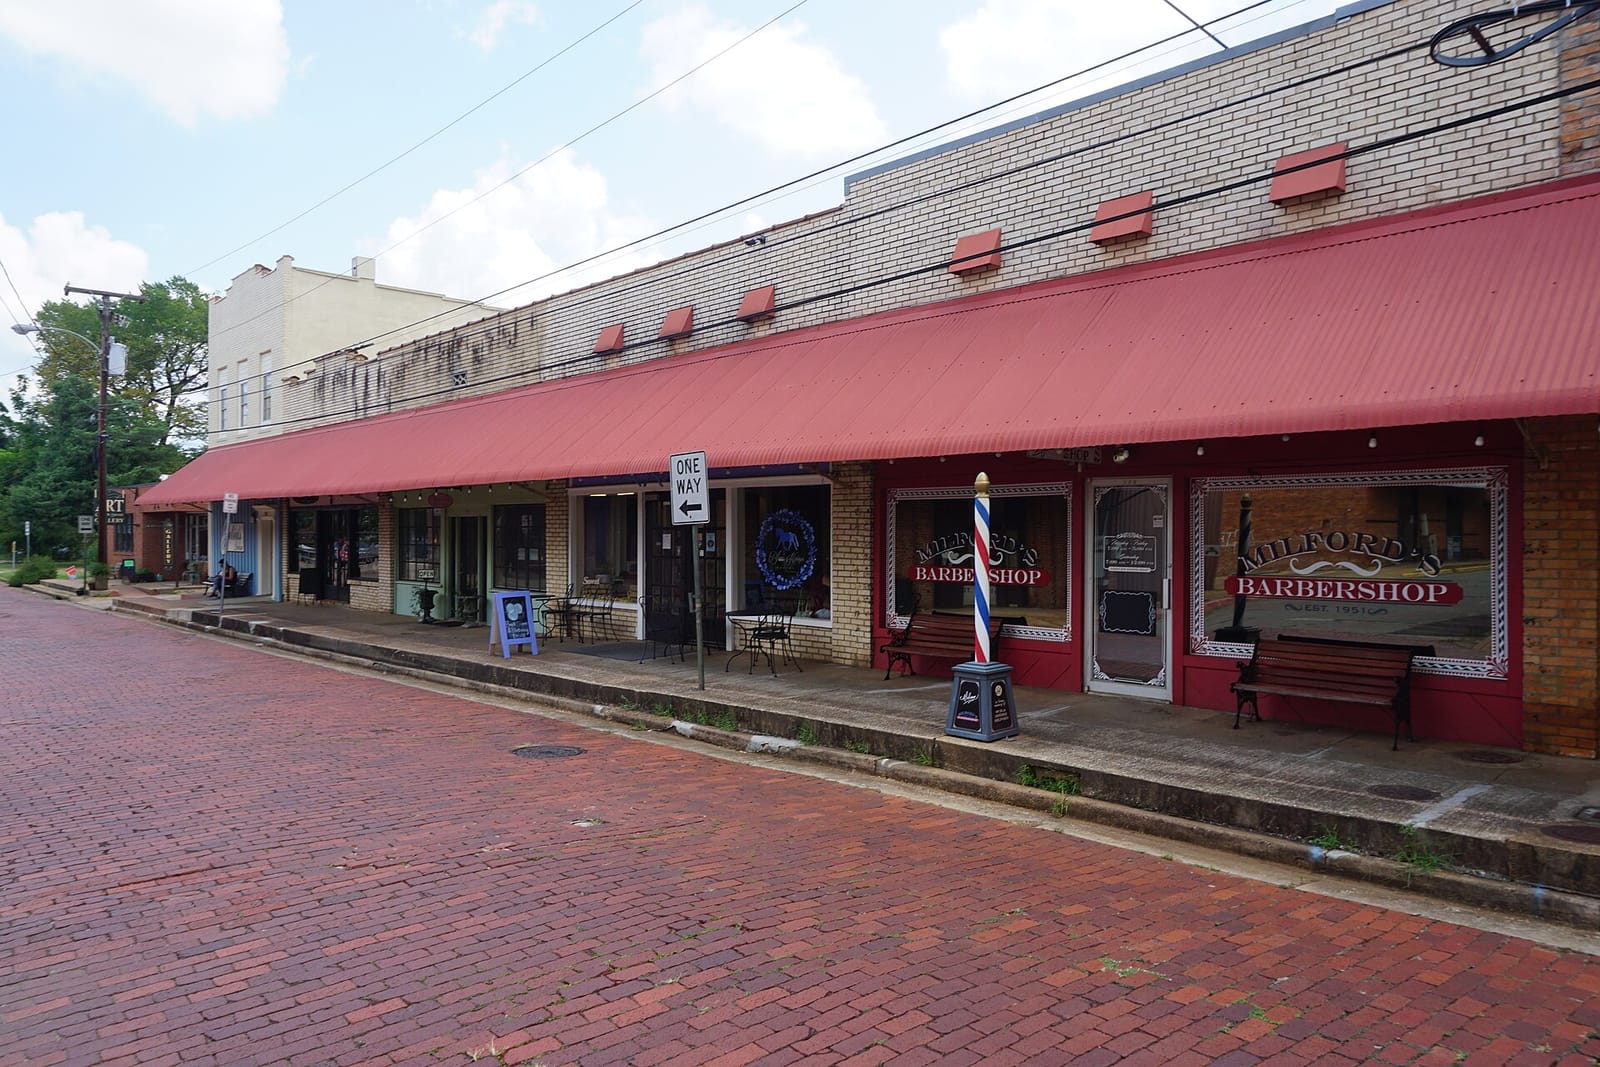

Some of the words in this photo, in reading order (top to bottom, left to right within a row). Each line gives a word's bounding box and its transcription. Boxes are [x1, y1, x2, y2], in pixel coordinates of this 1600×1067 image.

[676, 457, 700, 475] ONE
[676, 477, 701, 495] WAY
[1238, 530, 1444, 578] MILFORD'S
[915, 567, 1042, 585] BARBESHOP
[1237, 577, 1449, 603] BARBERSHOP
[1304, 604, 1329, 613] EST.
[1335, 605, 1368, 615] 1951
